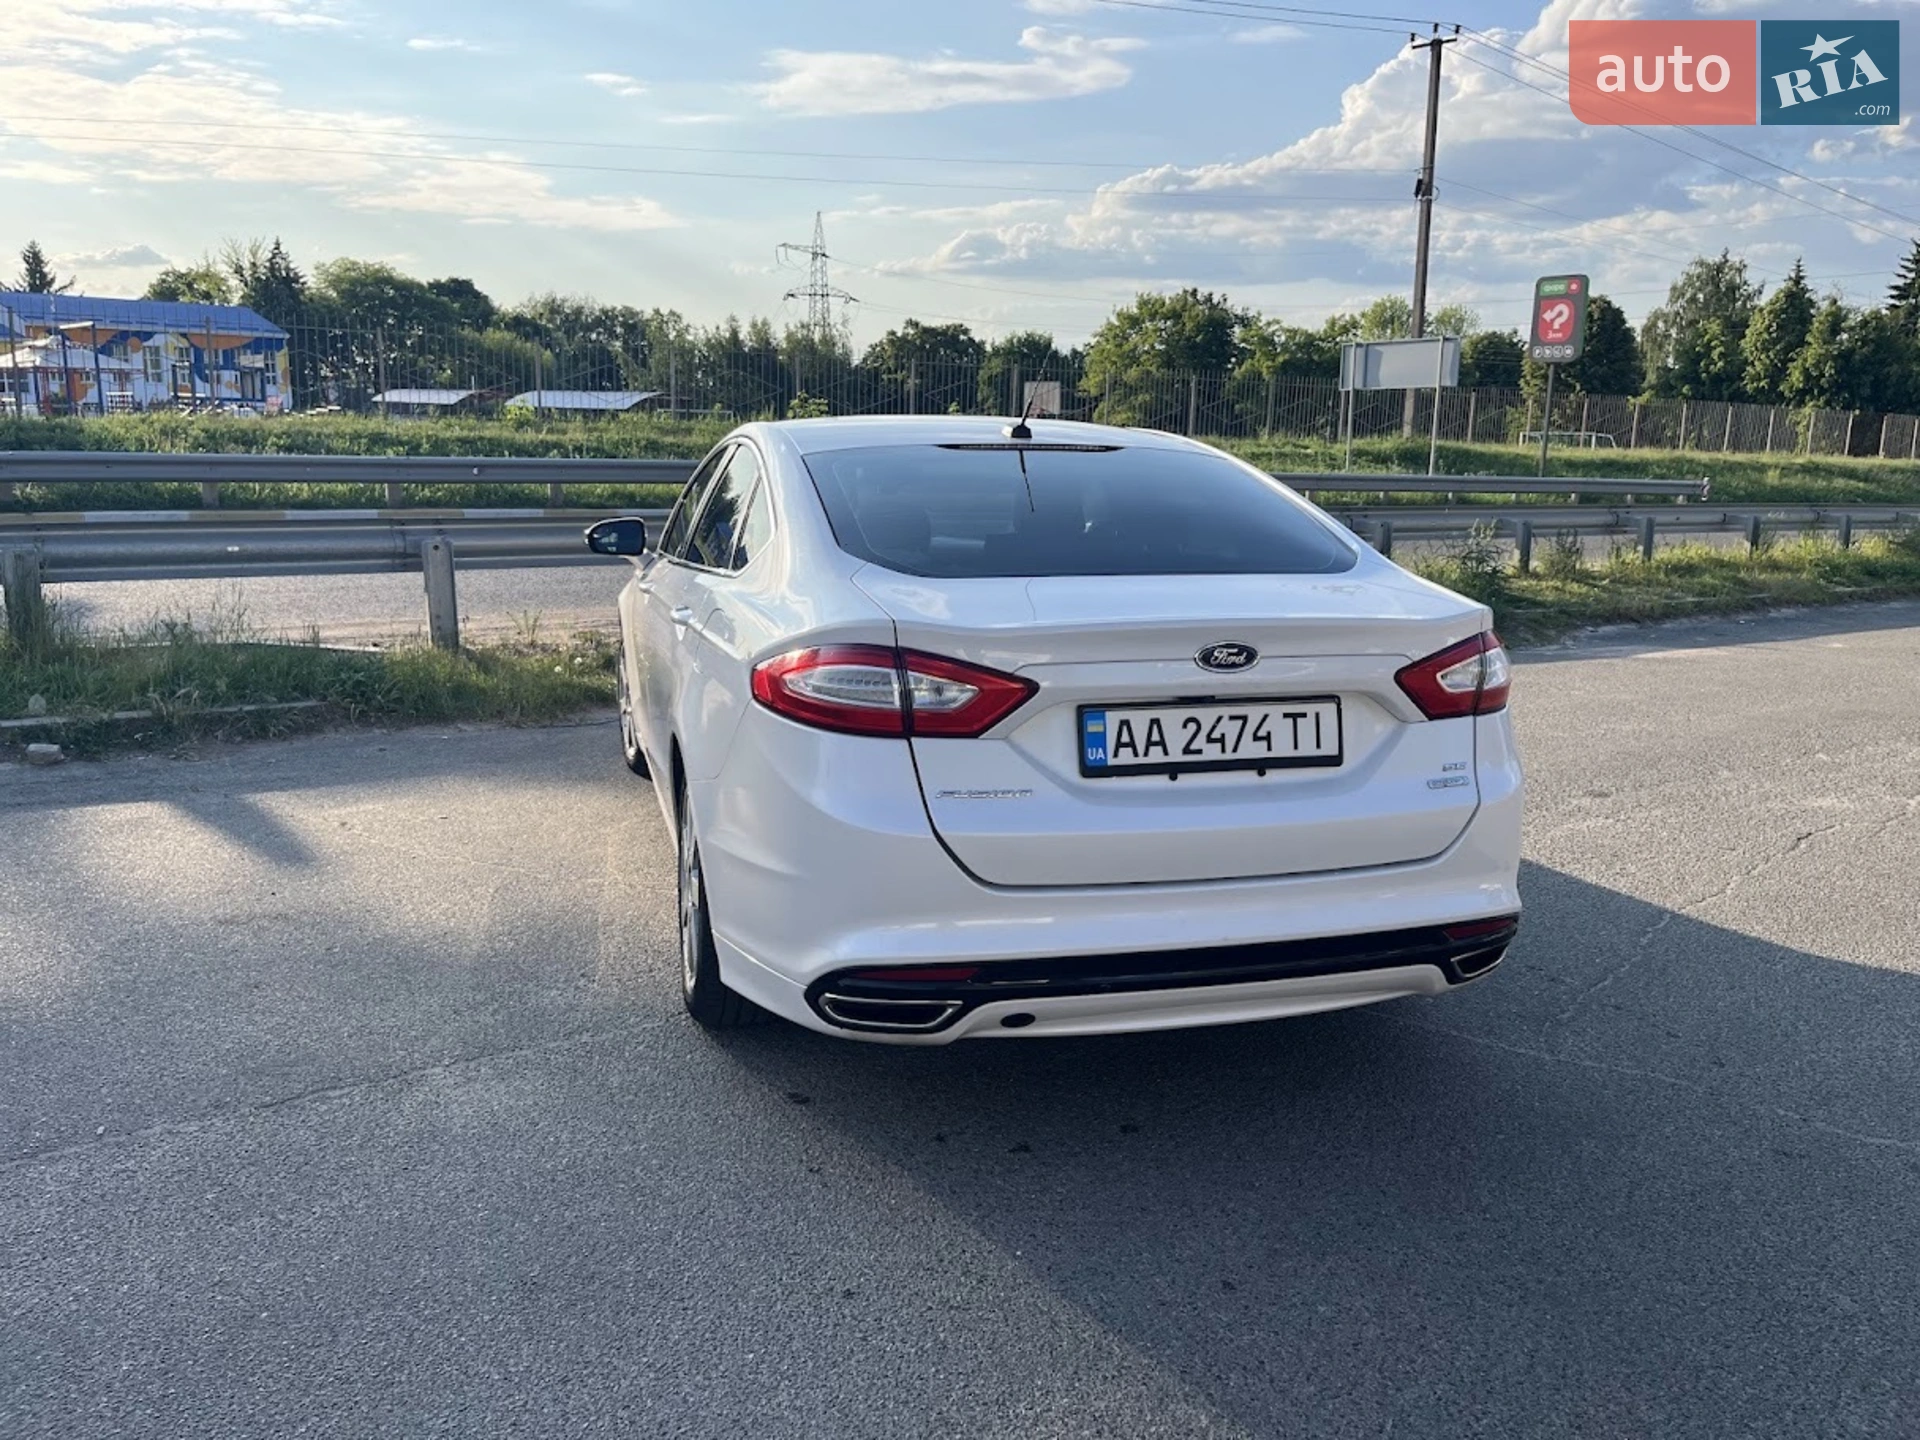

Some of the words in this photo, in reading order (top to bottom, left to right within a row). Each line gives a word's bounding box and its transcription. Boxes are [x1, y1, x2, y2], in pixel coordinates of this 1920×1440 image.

[1210, 648, 1248, 665] Ford
[1112, 718, 1170, 759] AA
[1181, 713, 1273, 756] 2474
[1283, 711, 1322, 751] TI
[1087, 747, 1105, 760] UA
